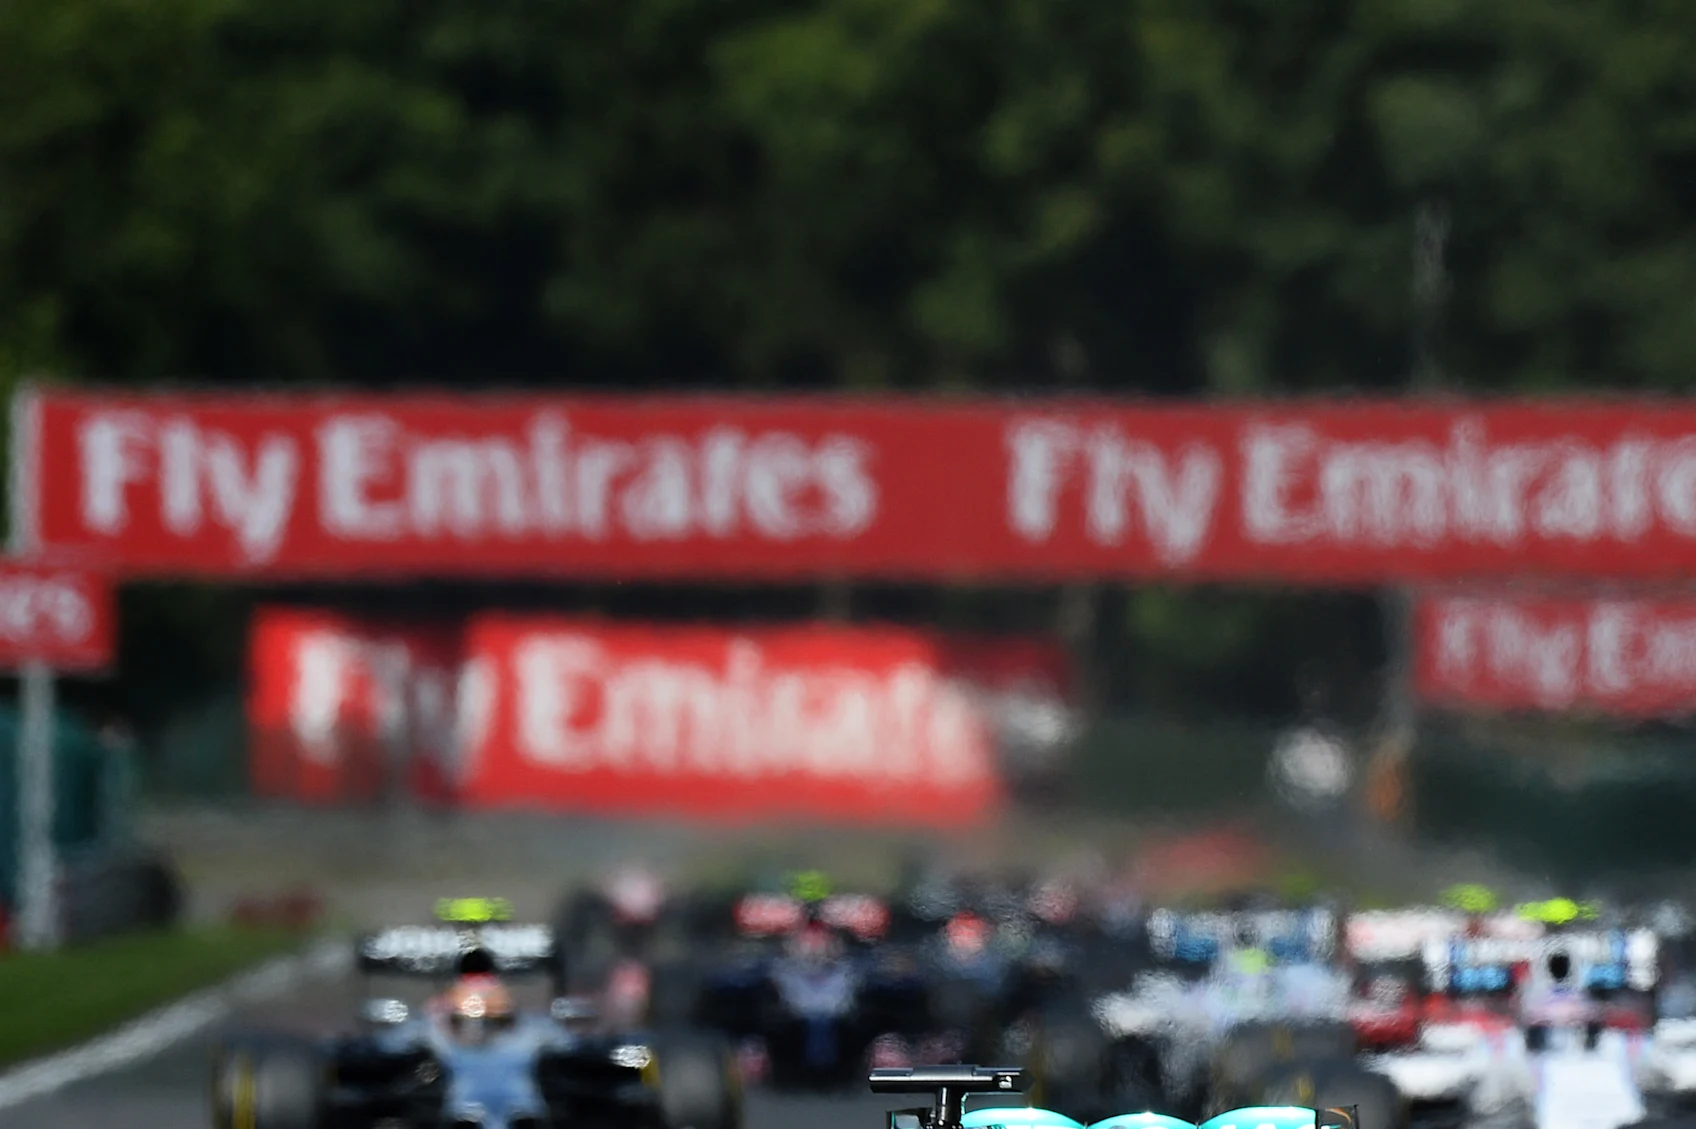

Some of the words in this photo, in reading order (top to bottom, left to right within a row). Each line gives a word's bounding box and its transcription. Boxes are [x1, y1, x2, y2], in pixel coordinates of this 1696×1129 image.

[77, 409, 298, 567] Fly
[317, 406, 878, 542] Emirates
[1007, 416, 1222, 566] Fly
[1433, 597, 1574, 706] Fly
